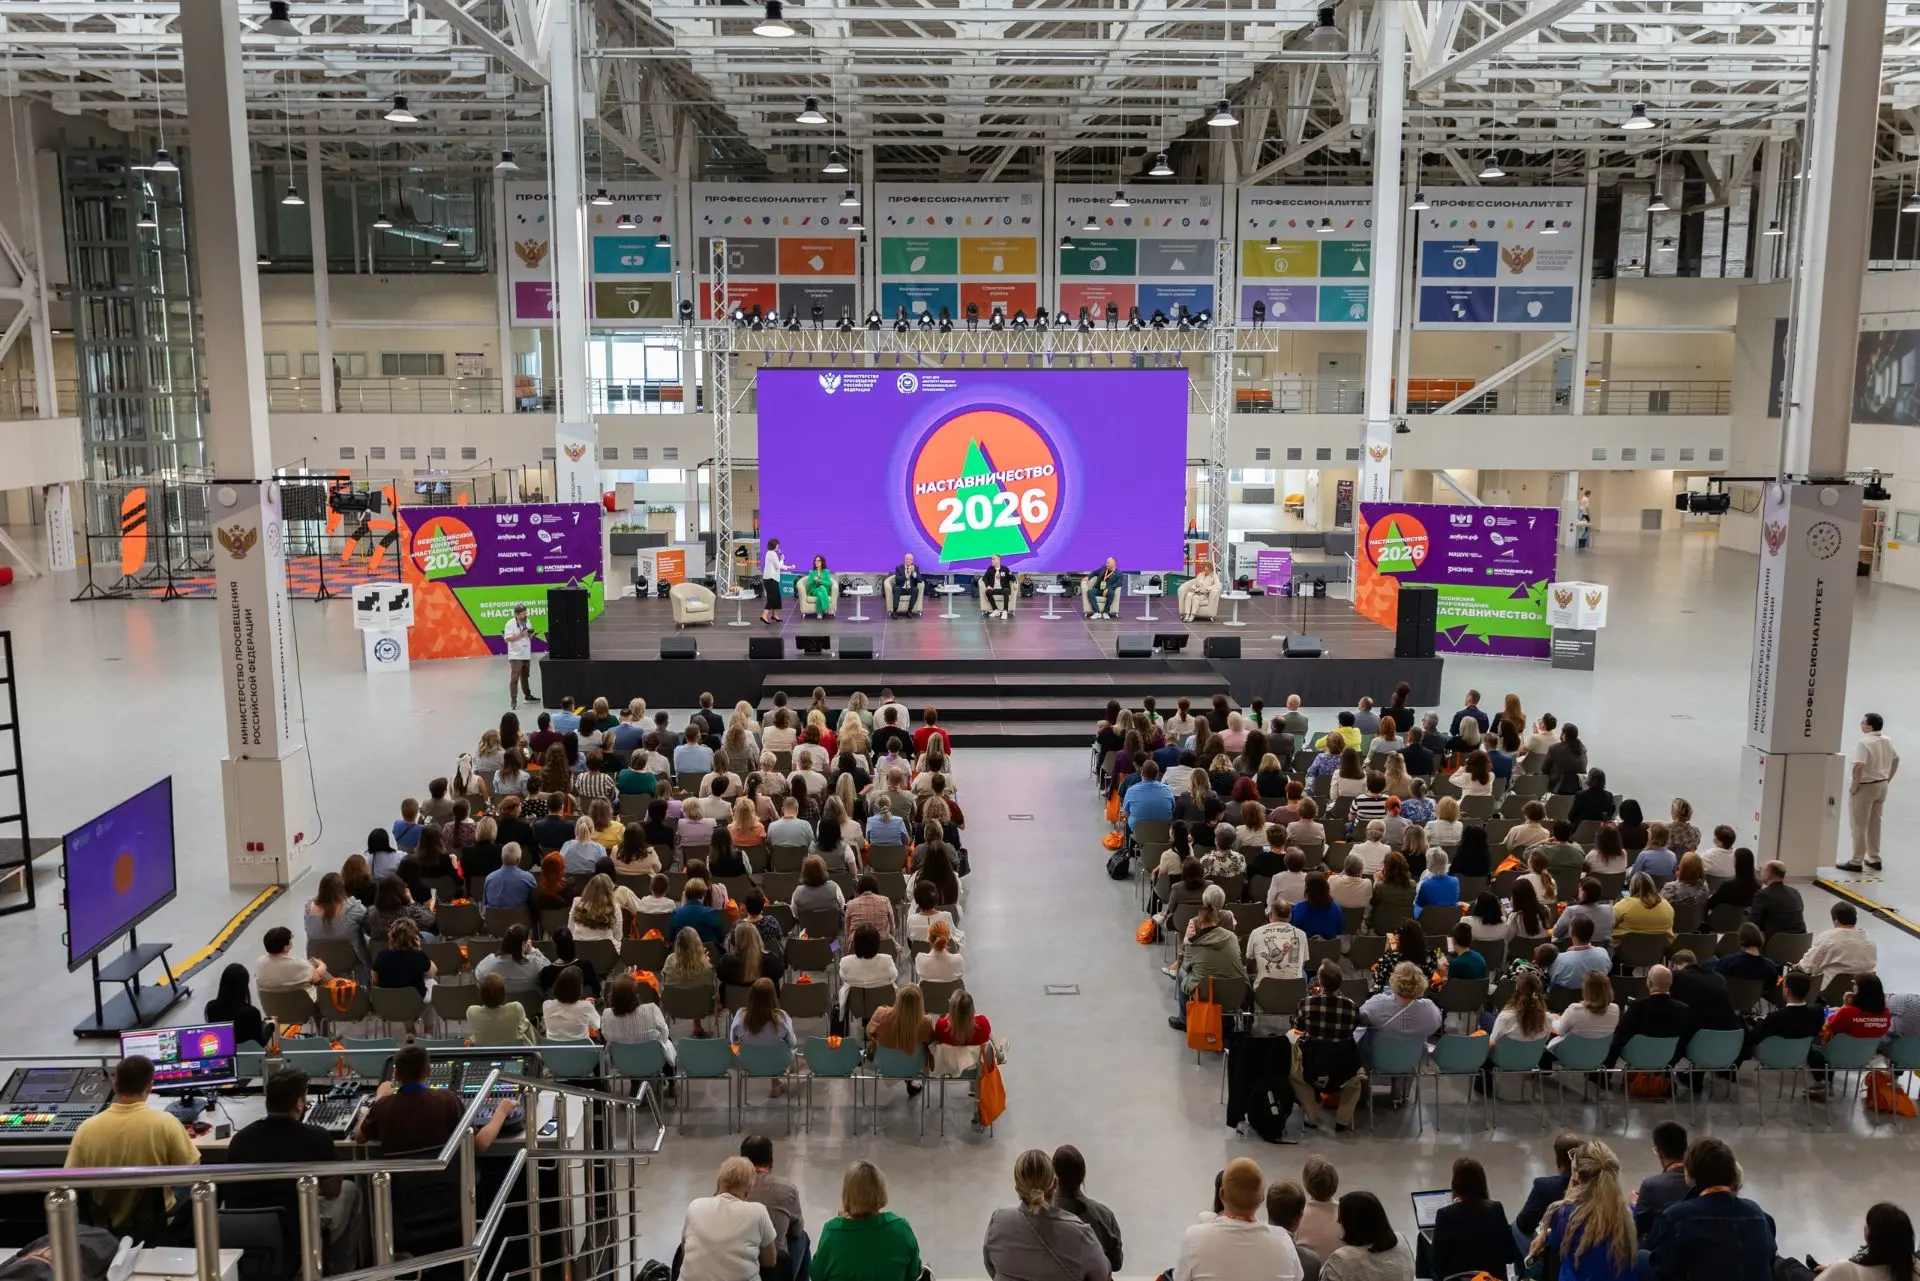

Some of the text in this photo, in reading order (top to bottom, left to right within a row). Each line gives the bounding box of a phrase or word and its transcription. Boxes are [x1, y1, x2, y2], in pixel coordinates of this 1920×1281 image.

[1068, 197, 1189, 205] ПРОФЕСИОНАЛИТЕТ
[1431, 200, 1574, 208] ПРОФЕССИОНАЛИТЕТ
[915, 464, 1055, 495] НАСТАВНИЧЕСТВО
[936, 488, 1049, 533] 2026
[417, 532, 473, 545] ВСЕРОССИЙСКИЙ
[430, 540, 460, 549] КОНКУРС
[1369, 536, 1428, 545] НАСТАВНИЧЕСТВО
[1449, 533, 1478, 541] добро.рф
[424, 550, 473, 571] 2026
[1377, 545, 1424, 561] 2026
[1753, 567, 1771, 732] МИНИСТЕРСТВО ПРОСВЕЩЕНИЯ
[1804, 578, 1824, 738] ПРОФЕССИОНАЛИТЕТ
[231, 581, 249, 745] МИНИСТЕРСТВО ПРОСВЕЩЕНИЯ
[276, 592, 289, 739] ПРОФЕССИОНАЛИТЕТ
[1760, 595, 1776, 734] РОССИЙСКОЙ ФЕДЕРАЦИИ
[244, 608, 261, 745] РОССИЙСКОЙ ФЕДЕРАЦИИ
